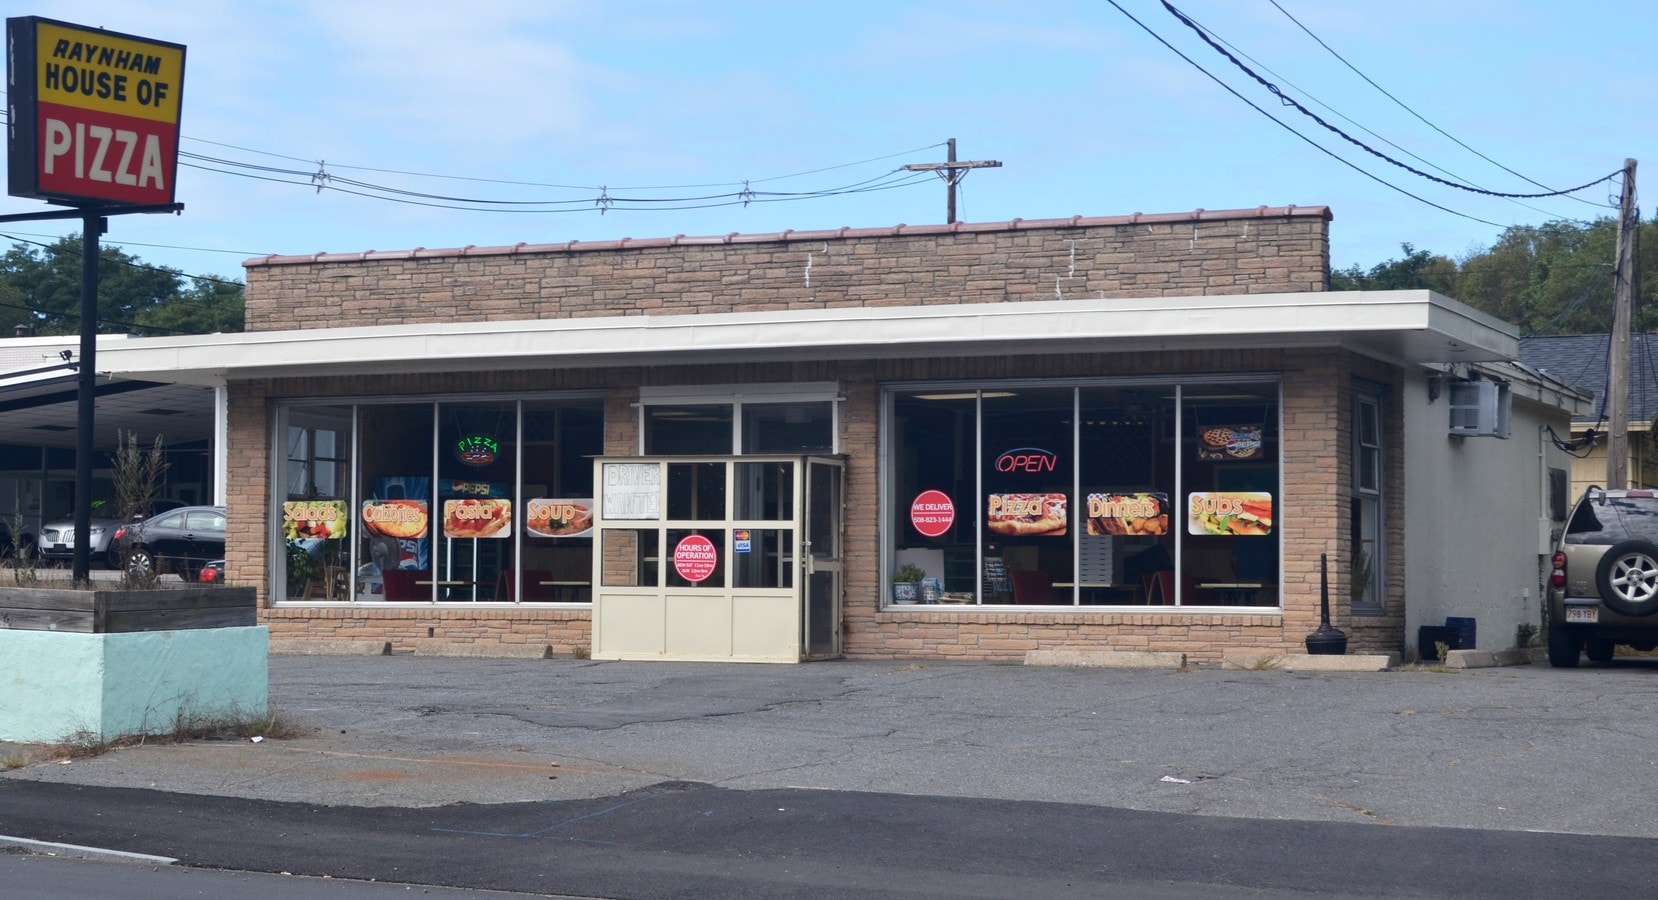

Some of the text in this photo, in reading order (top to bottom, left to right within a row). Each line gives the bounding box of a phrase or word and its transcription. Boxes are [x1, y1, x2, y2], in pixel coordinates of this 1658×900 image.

[53, 38, 162, 75] RAYNHAM
[45, 62, 169, 107] HOUSE OF
[44, 118, 165, 190] PIZZA
[458, 436, 498, 453] PIZZA
[997, 454, 1057, 473] OPEN
[462, 482, 490, 496] PEPSI
[283, 503, 337, 521] Salads
[362, 504, 421, 523] Calzones
[446, 502, 493, 520] Pasta
[528, 502, 576, 524] Soup
[913, 503, 953, 511] WE DELIVER
[989, 494, 1043, 516] Pizza
[1088, 496, 1155, 518] Dinners
[1191, 494, 1244, 515] Subs
[399, 539, 418, 555] PSI
[676, 551, 714, 560] OPERATION
[702, 544, 712, 552] OF
